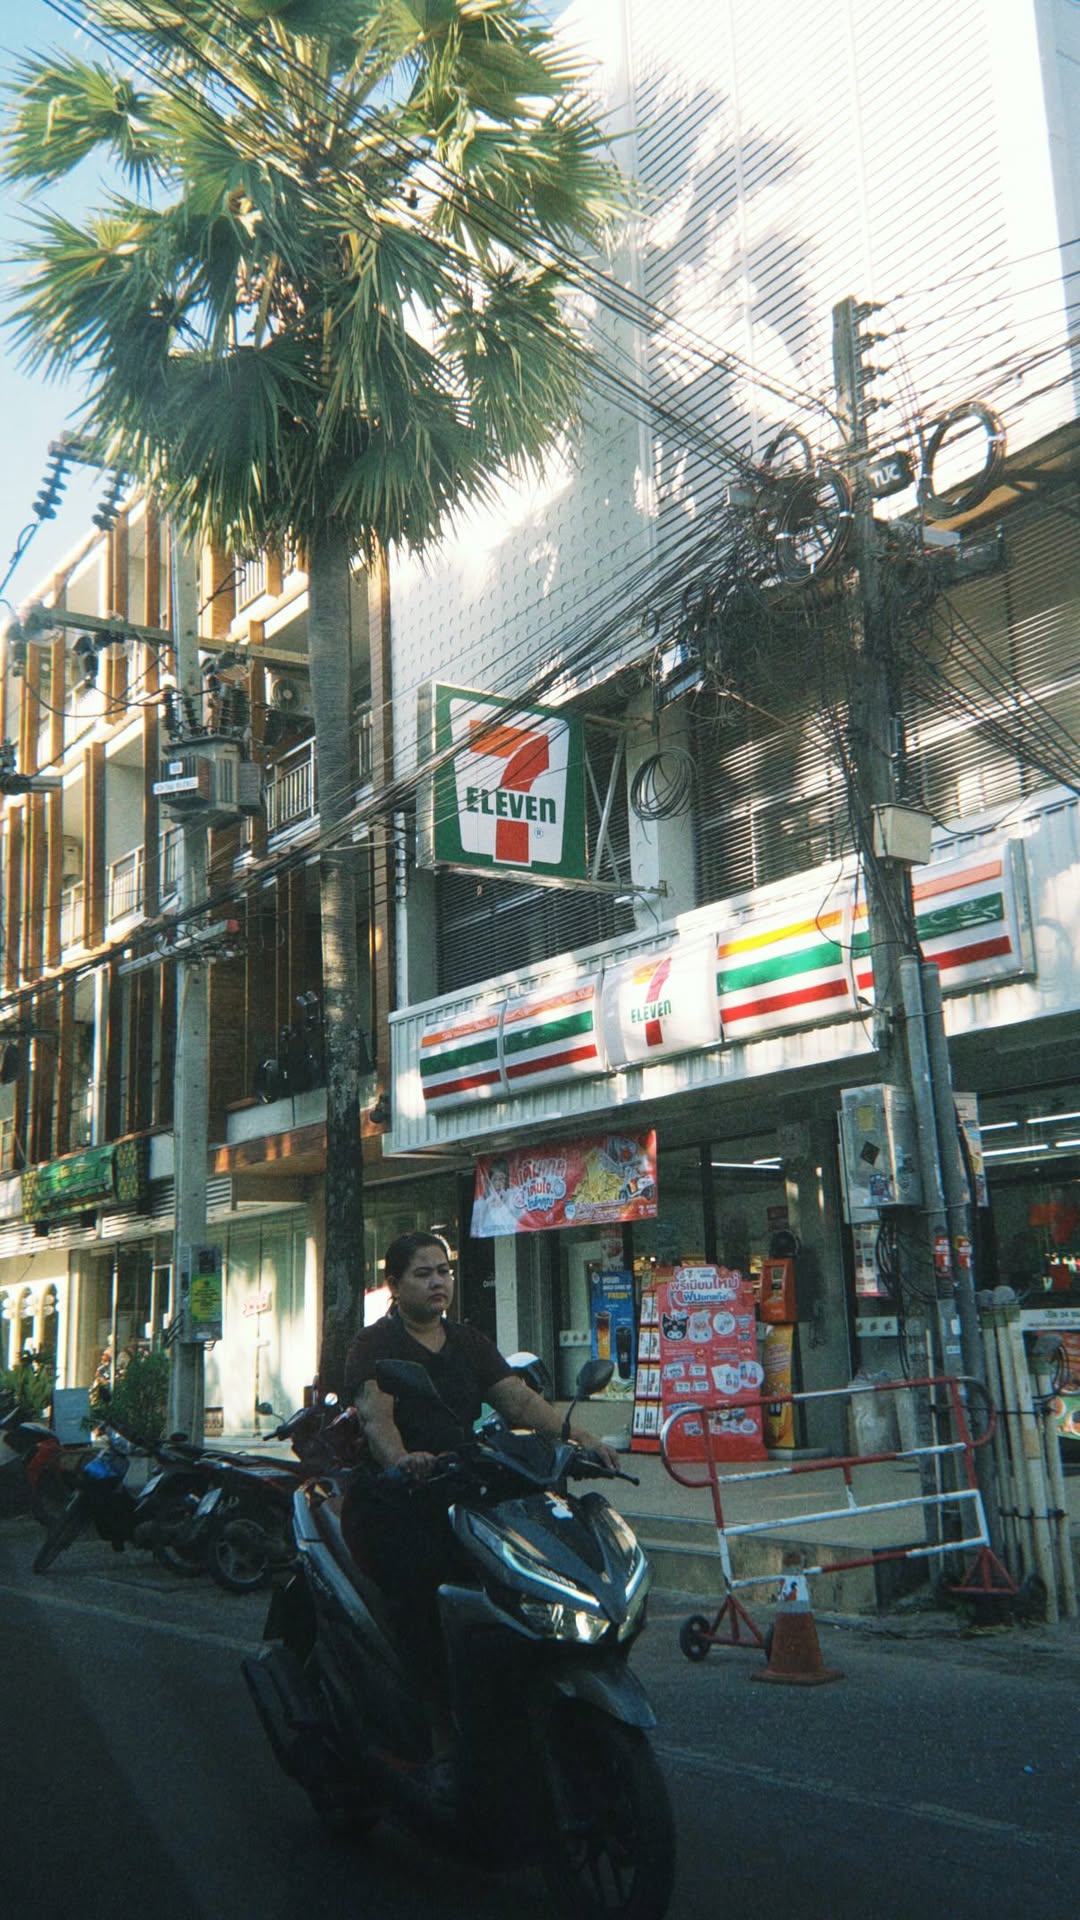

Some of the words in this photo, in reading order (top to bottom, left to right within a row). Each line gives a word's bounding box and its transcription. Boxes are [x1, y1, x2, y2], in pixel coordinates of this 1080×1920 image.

[871, 462, 900, 488] TUC
[466, 786, 557, 824] ELEVEN
[469, 719, 549, 863] 7
[631, 999, 672, 1023] ELEVEN
[632, 956, 672, 1047] 7
